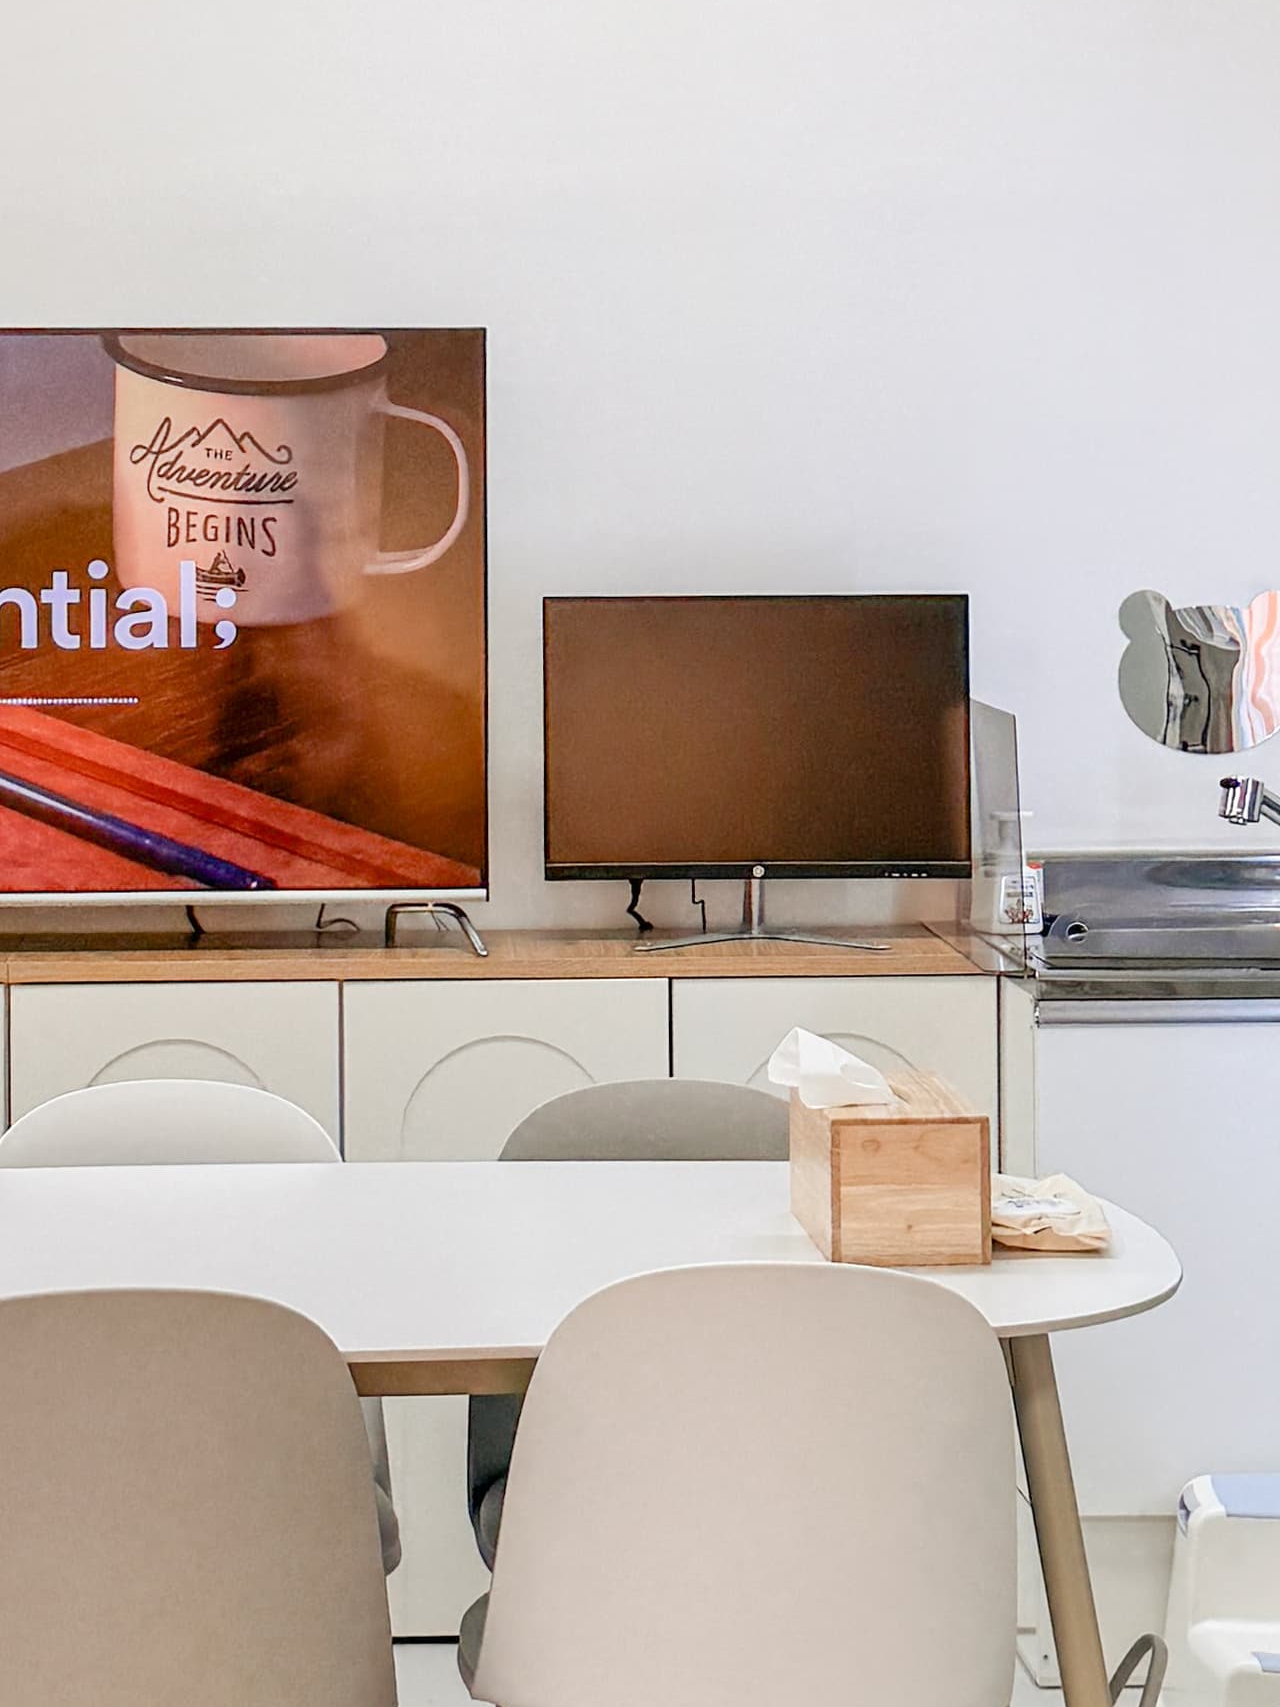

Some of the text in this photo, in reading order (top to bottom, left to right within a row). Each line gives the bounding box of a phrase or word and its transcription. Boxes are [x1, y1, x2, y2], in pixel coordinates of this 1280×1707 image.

[130, 416, 299, 502] Adventure
[204, 447, 233, 461] THE
[167, 506, 277, 557] BEGINS
